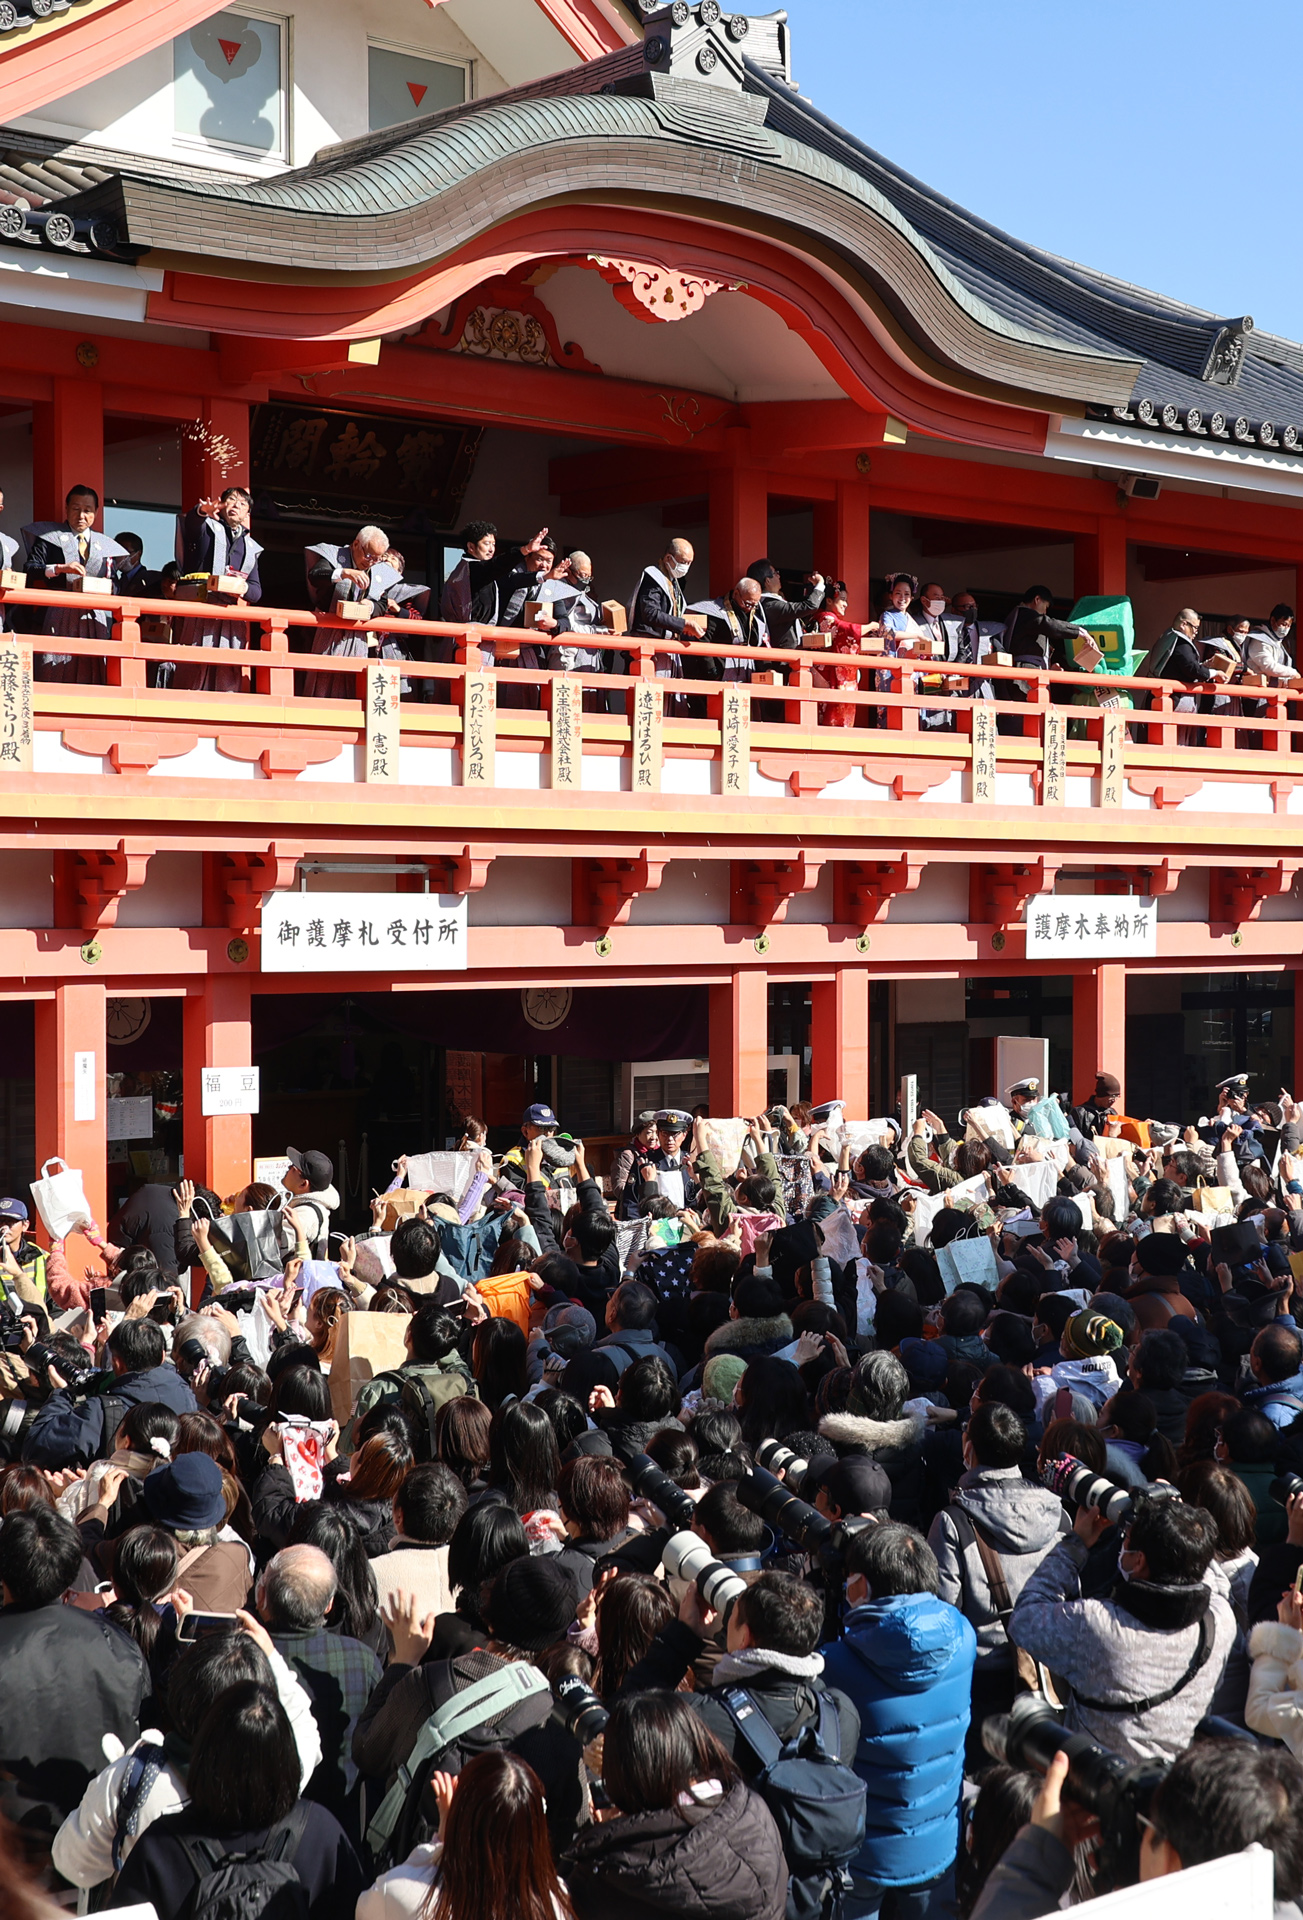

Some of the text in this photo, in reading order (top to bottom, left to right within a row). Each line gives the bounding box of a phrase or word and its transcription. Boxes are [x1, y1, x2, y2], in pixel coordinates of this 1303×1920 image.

[390, 674, 399, 710] 年男
[486, 682, 496, 712] 年男
[654, 691, 662, 724] 年男
[742, 698, 749, 729] 年男
[468, 682, 485, 780] つのだ☆ひろ殿
[276, 917, 459, 948] 御護摩札受付所
[1034, 912, 1149, 941] 護摩木奉納所
